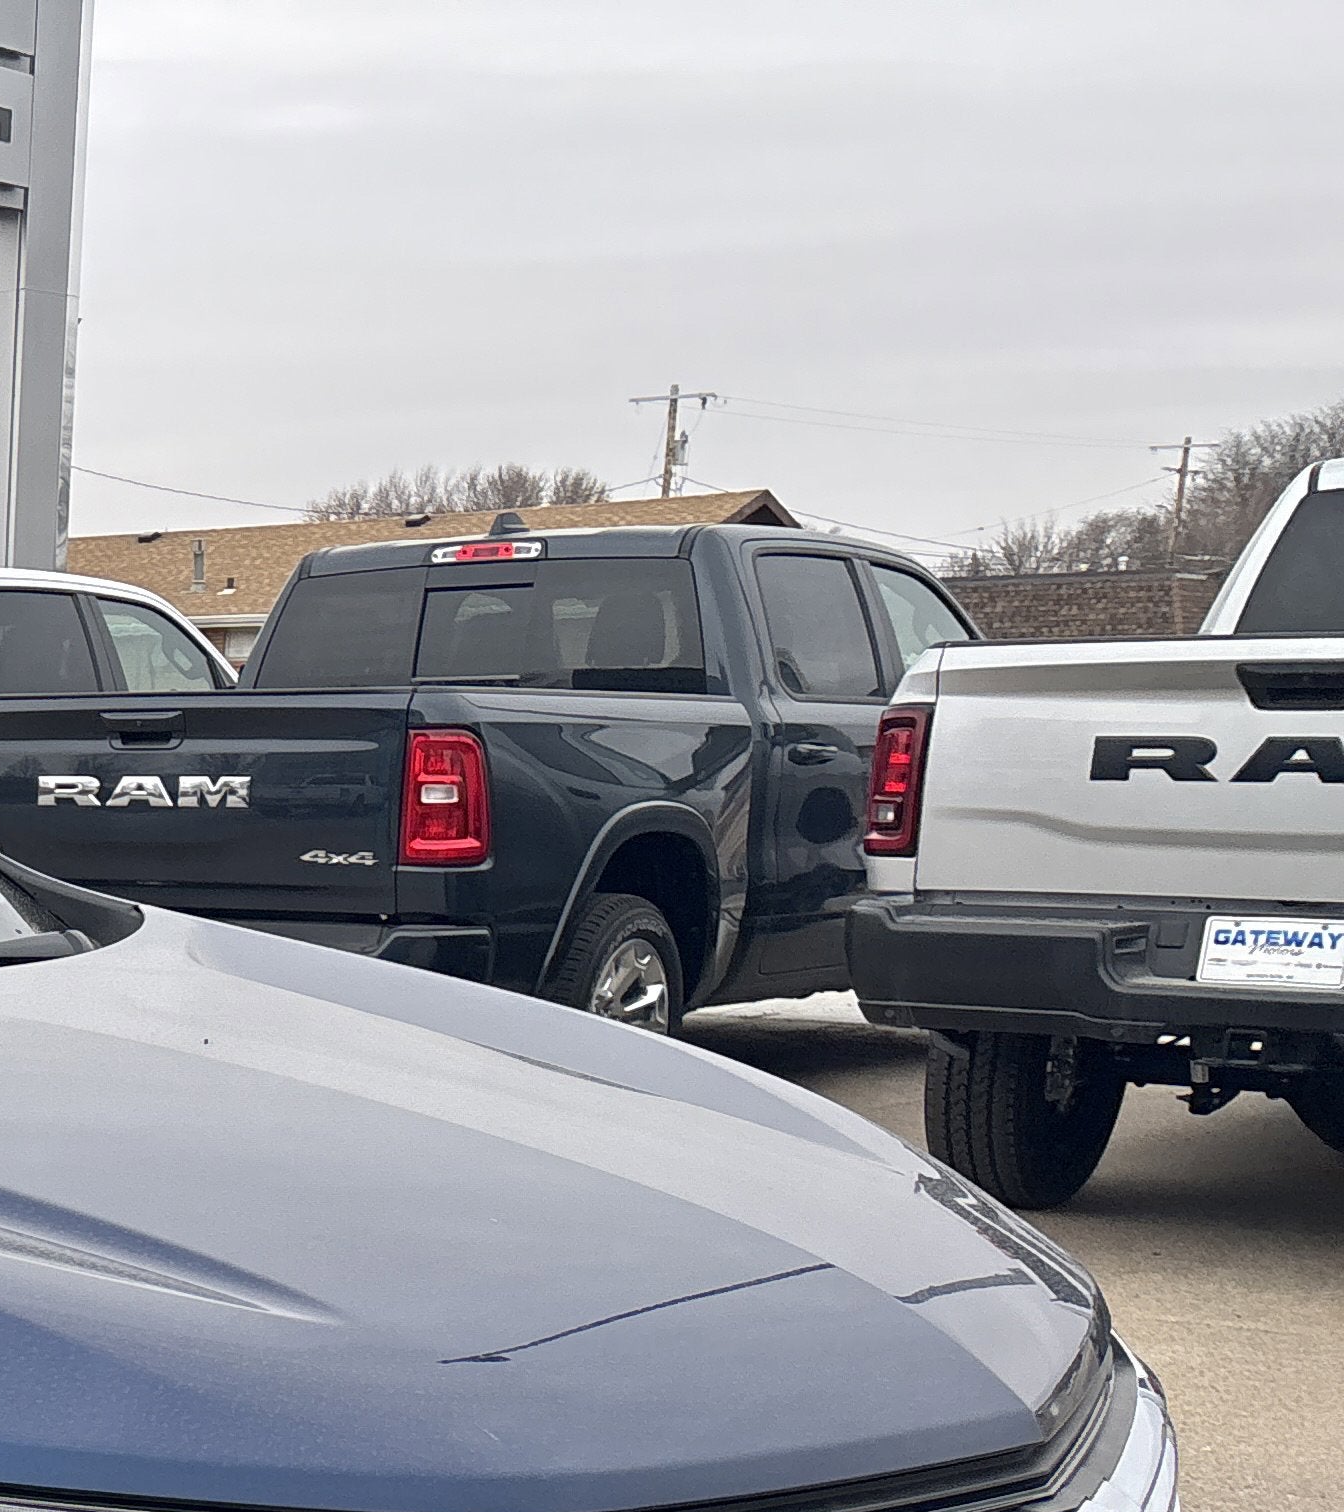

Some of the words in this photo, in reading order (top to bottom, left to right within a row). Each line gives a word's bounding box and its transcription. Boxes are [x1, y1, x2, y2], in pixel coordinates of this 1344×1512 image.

[1089, 735, 1344, 784] RA
[36, 774, 252, 809] RAM
[298, 849, 380, 867] 4x4
[1213, 928, 1344, 950] GATEWAY
